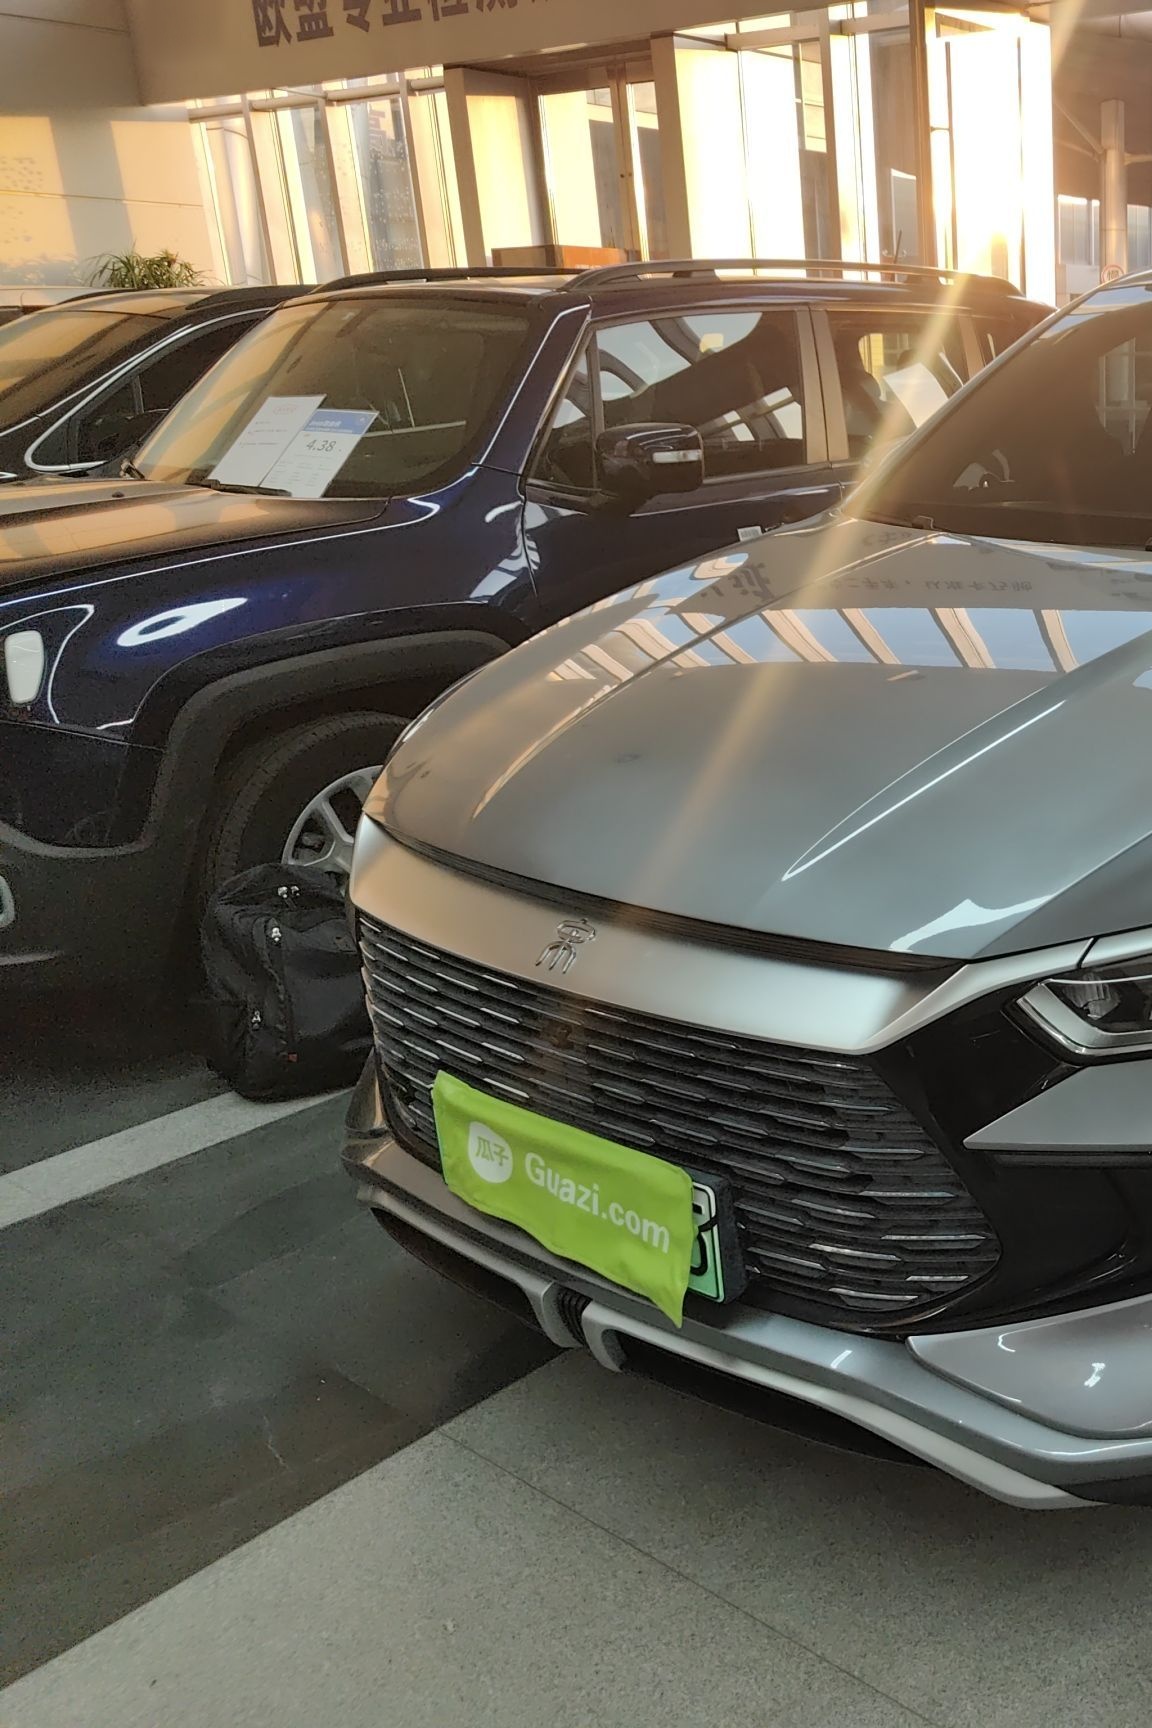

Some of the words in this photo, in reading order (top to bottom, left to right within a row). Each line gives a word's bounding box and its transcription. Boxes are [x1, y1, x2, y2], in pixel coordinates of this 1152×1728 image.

[306, 440, 336, 452] 4.38
[475, 1136, 509, 1167] 瓜子
[524, 1152, 671, 1255] Guazi.com
